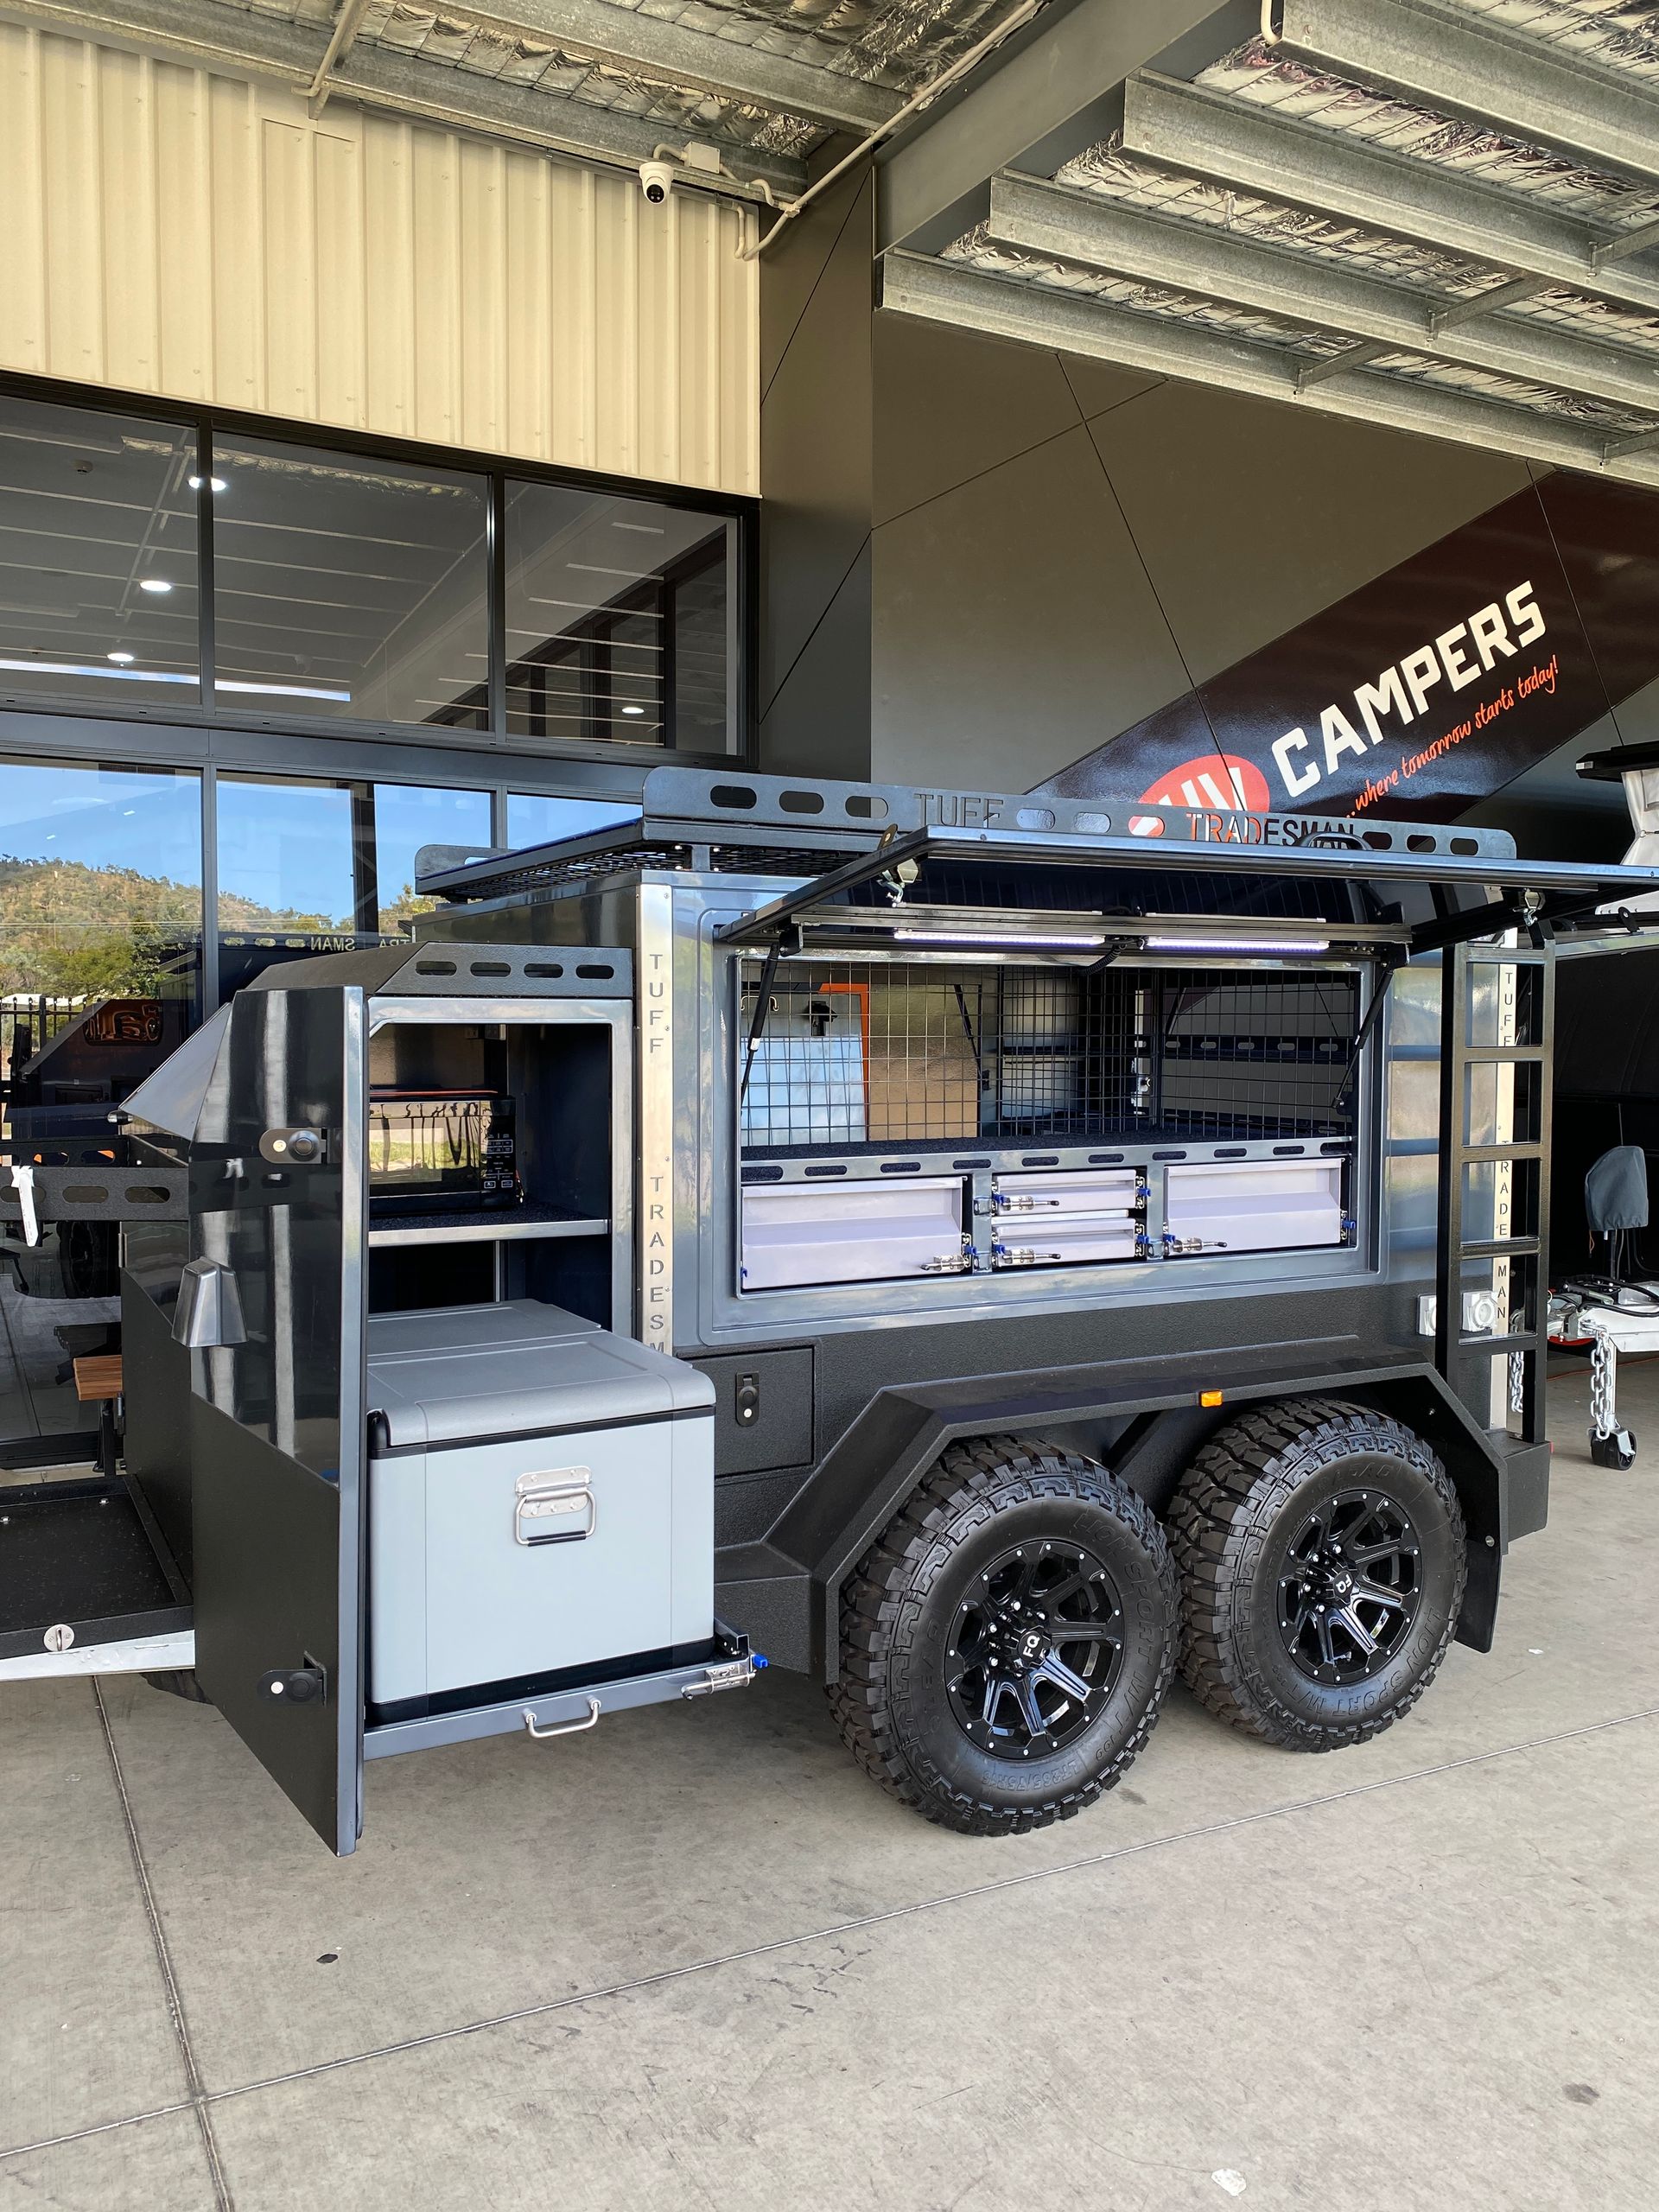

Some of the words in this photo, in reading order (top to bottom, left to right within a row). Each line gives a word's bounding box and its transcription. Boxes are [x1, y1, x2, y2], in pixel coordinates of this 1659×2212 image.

[1272, 580, 1547, 798] CAMPERS
[1402, 721, 1471, 778] tomorrow
[1475, 688, 1515, 729] starts
[1517, 654, 1559, 699] today!
[913, 793, 1004, 829] TUFF
[649, 954, 664, 1053] TUFF
[1503, 972, 1514, 1046] TUFF
[1022, 1635, 1040, 1658] FQ
[1124, 1561, 1156, 1667] SPORT
[1406, 1606, 1443, 1675] LION
[1115, 1670, 1148, 1733] M/T
[1332, 1669, 1408, 1717] SPORT
